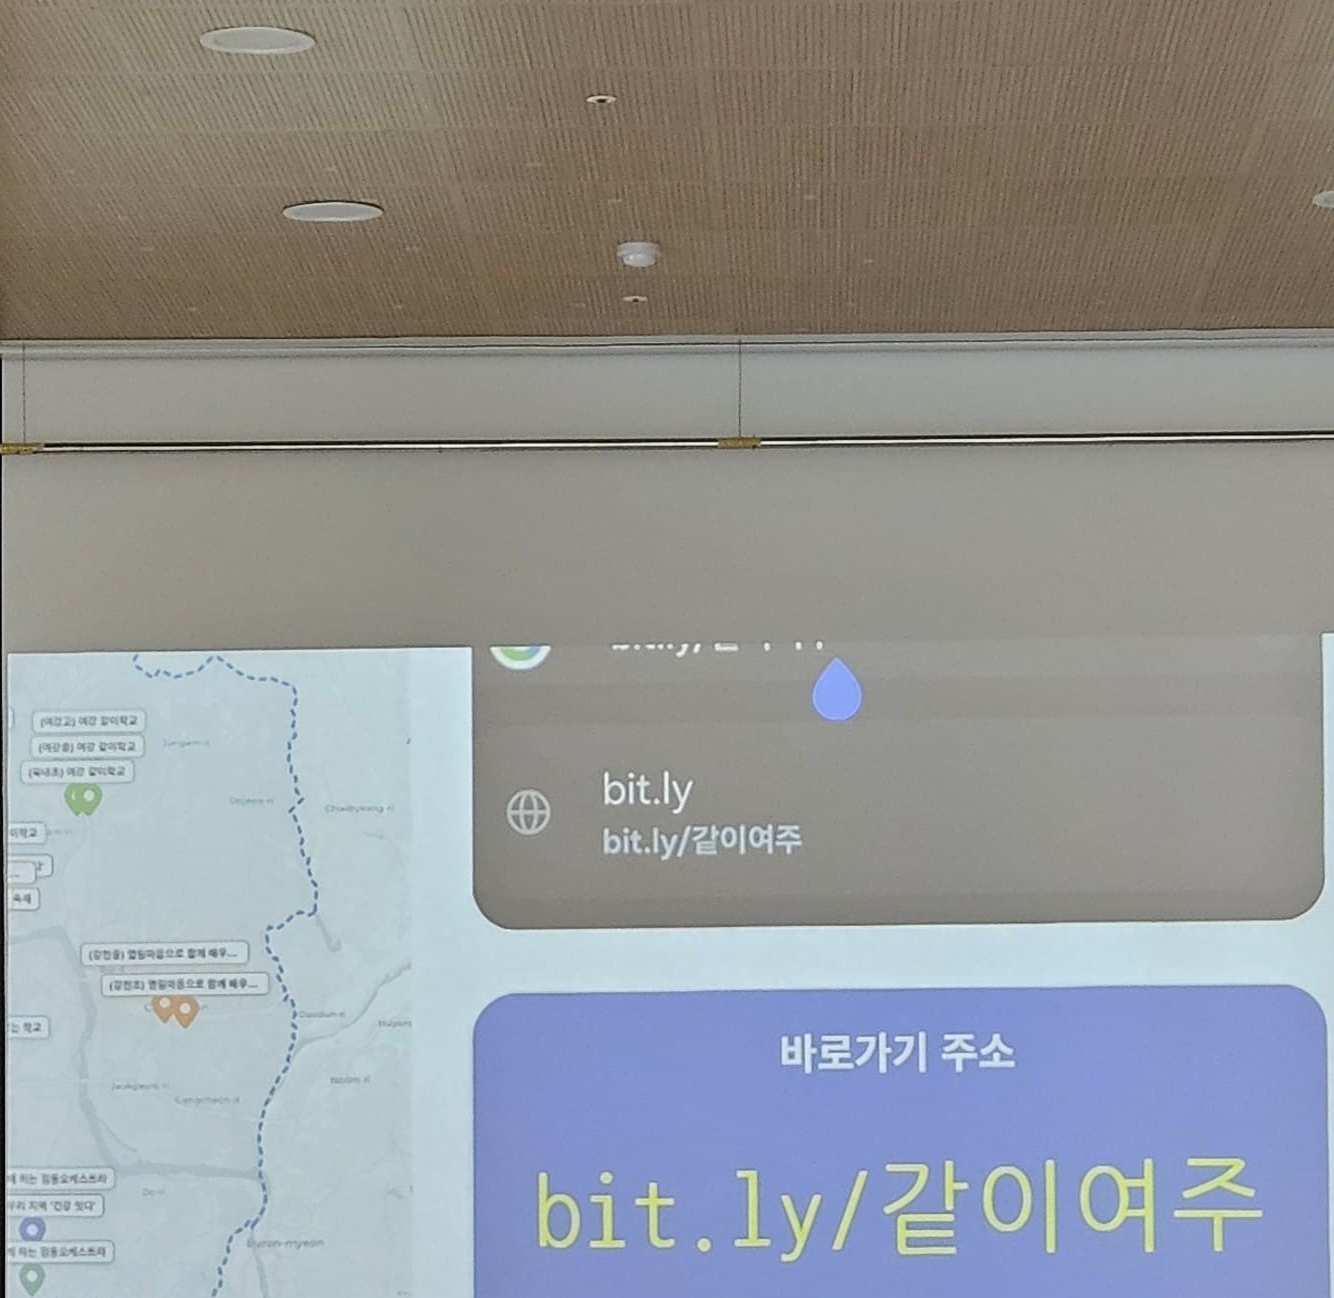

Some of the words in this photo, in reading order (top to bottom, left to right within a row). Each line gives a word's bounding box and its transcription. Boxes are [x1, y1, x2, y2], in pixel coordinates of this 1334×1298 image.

[603, 770, 694, 815] bit.ly
[602, 823, 803, 861] bit.ly/같이여주
[780, 1031, 929, 1074] 바로가기
[941, 1032, 1017, 1072] 주소
[535, 1156, 1265, 1262] bit.ly/같이여주
